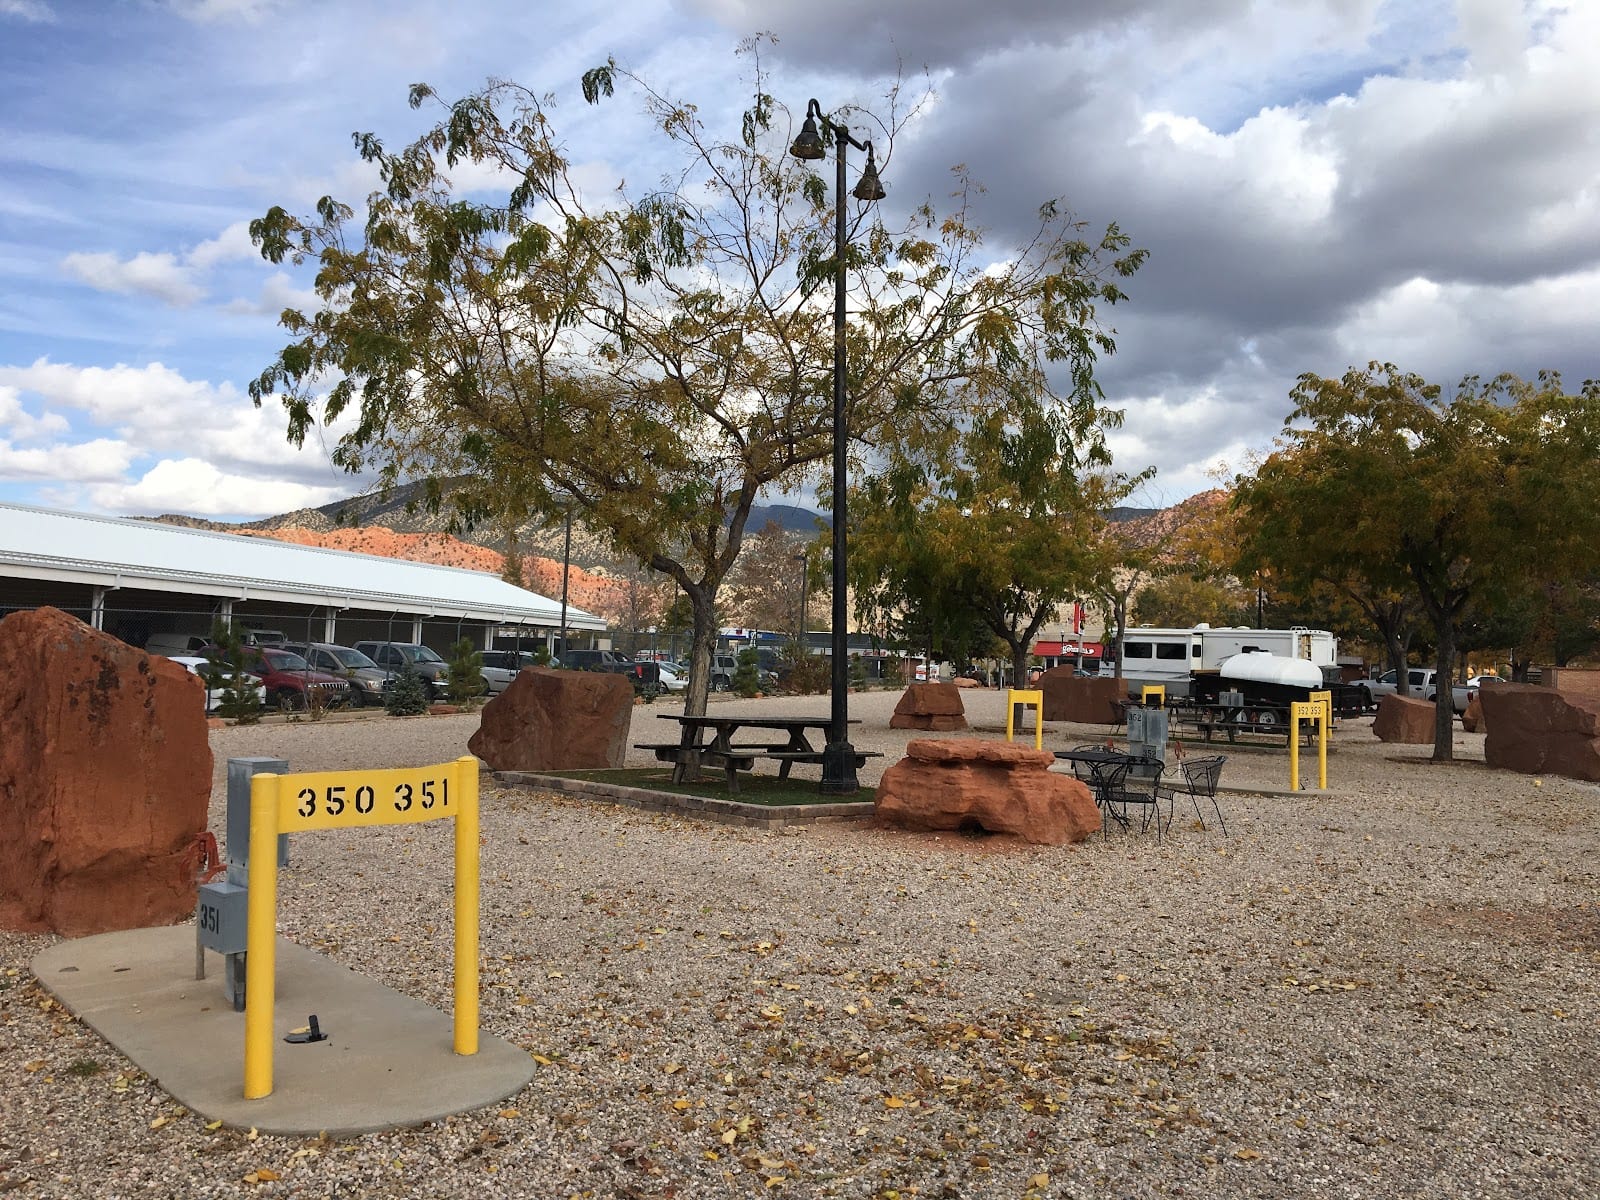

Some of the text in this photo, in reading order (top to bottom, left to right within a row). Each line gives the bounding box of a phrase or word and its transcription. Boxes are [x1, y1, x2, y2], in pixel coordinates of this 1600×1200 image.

[1129, 713, 1141, 722] 352
[1298, 706, 1308, 715] 352
[297, 778, 448, 818] 350 351
[201, 904, 219, 934] 351
